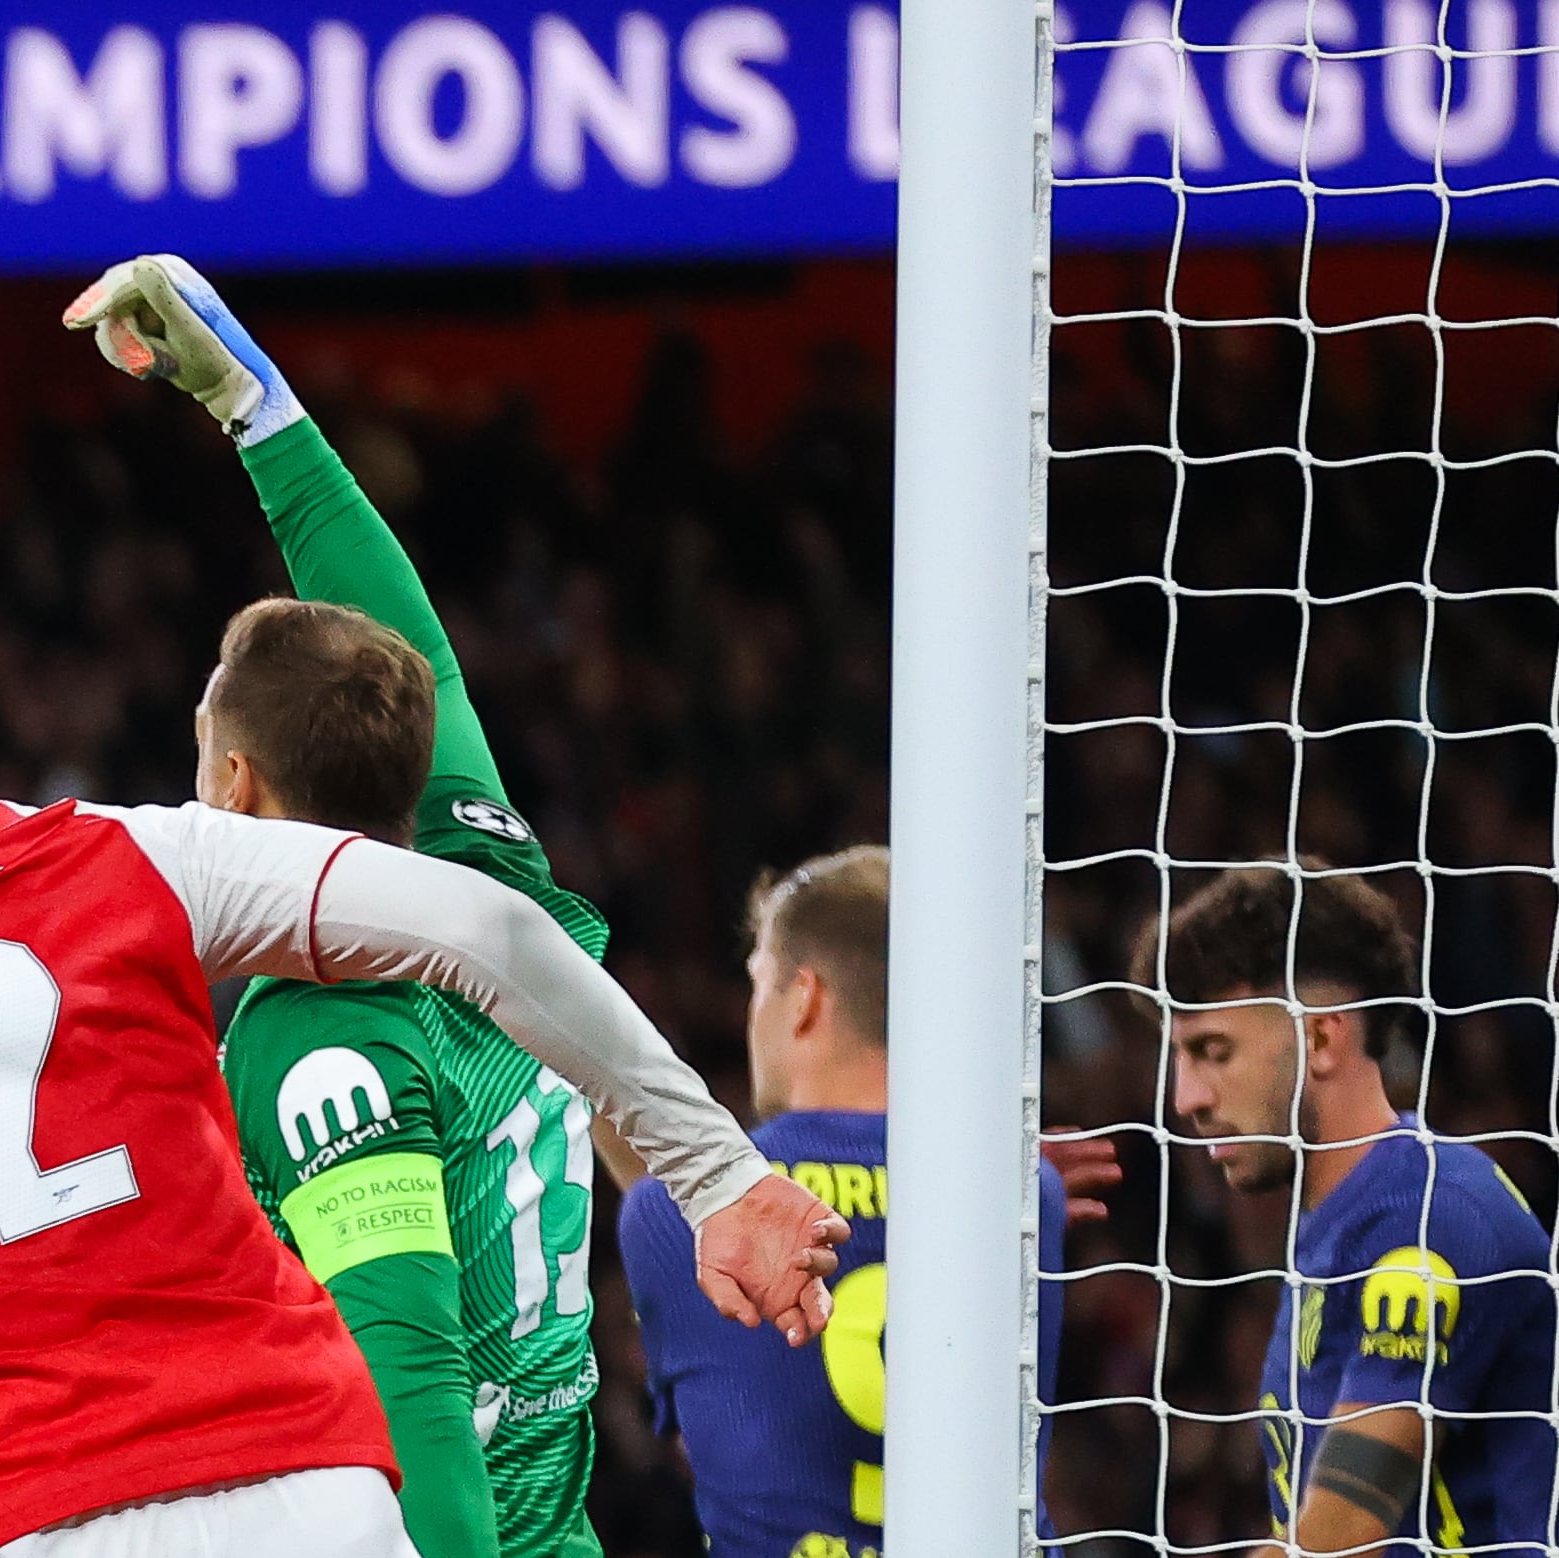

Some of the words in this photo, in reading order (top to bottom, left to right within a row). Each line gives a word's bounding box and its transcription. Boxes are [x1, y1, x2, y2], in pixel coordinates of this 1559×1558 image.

[846, 0, 1559, 182] LAGU
[316, 1198, 339, 1219] NO
[341, 1187, 365, 1204] TO
[370, 1178, 437, 1197] RACISM
[357, 1208, 433, 1232] RESPECT
